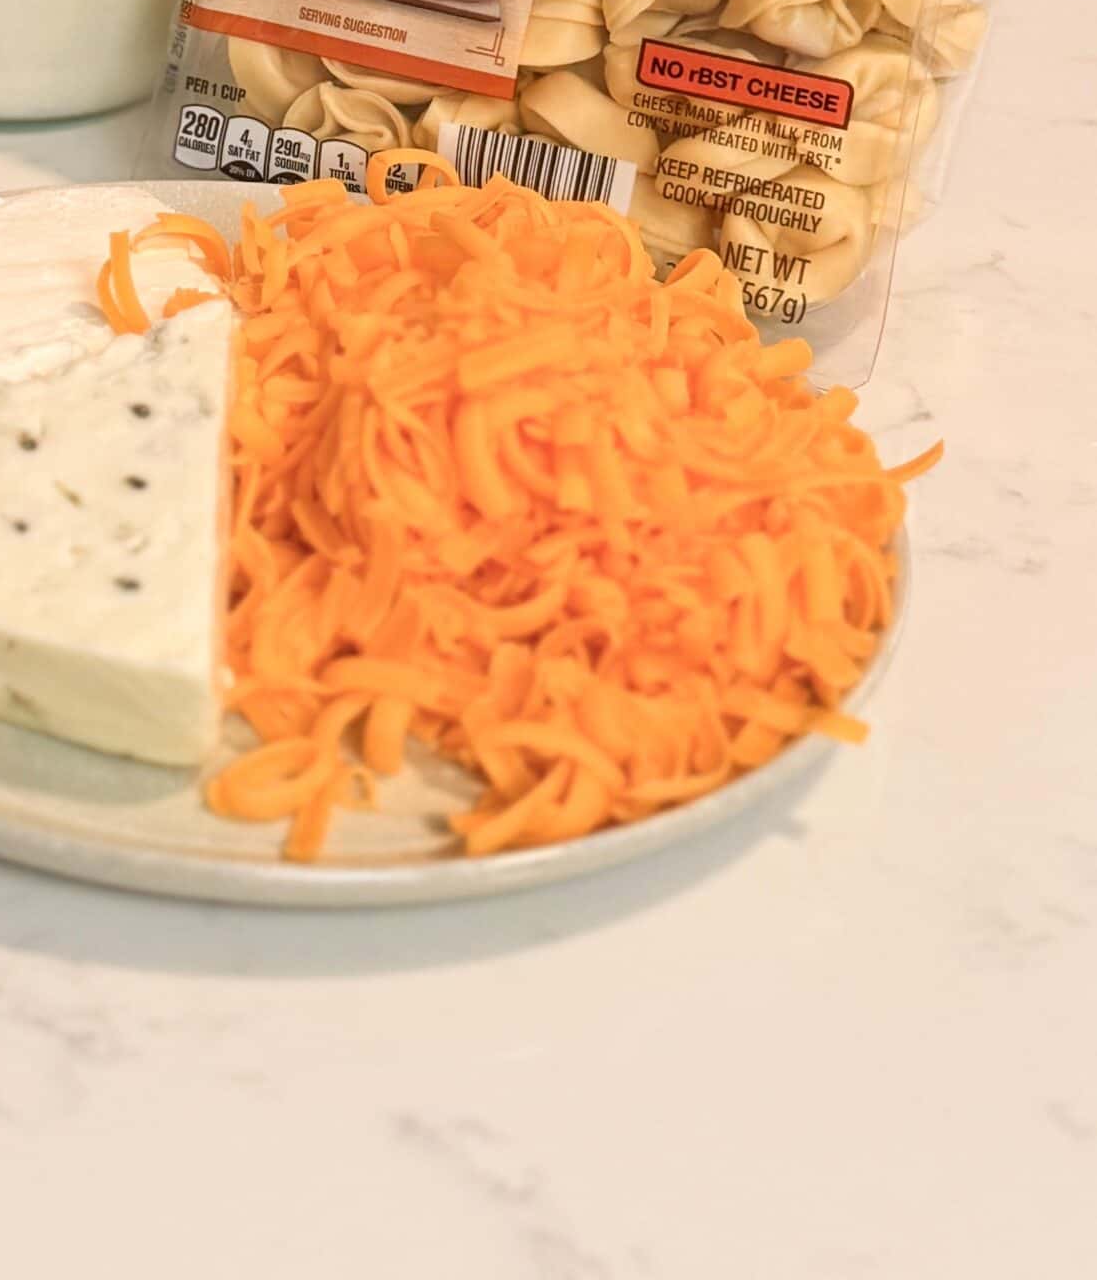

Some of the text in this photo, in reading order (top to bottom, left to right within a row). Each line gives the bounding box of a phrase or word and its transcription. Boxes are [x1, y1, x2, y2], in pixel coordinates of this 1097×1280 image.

[298, 6, 408, 44] SERVING SUGGESTION
[185, 76, 247, 103] PER 1 CUP
[650, 56, 841, 114] NO rBST CHEESE
[182, 110, 221, 141] 280
[627, 111, 671, 135] COW'S
[670, 120, 702, 140] NOT
[701, 129, 759, 154] TREATED
[761, 140, 798, 163] WITH
[632, 92, 683, 117] CHEESE
[684, 103, 724, 126] MADE
[726, 112, 762, 133] WITH
[803, 130, 843, 152] FROM
[178, 135, 216, 156] CALORIES
[226, 144, 261, 163] SAT FAT
[273, 156, 309, 175] SODIUM
[329, 168, 357, 182] TOTAL
[656, 156, 826, 211] KEEP REFRIGERATED
[385, 177, 415, 193] OTEIN
[662, 182, 823, 234] COOK THOROUGHLY
[723, 240, 811, 286] NET WT
[739, 278, 808, 324] 567g)
